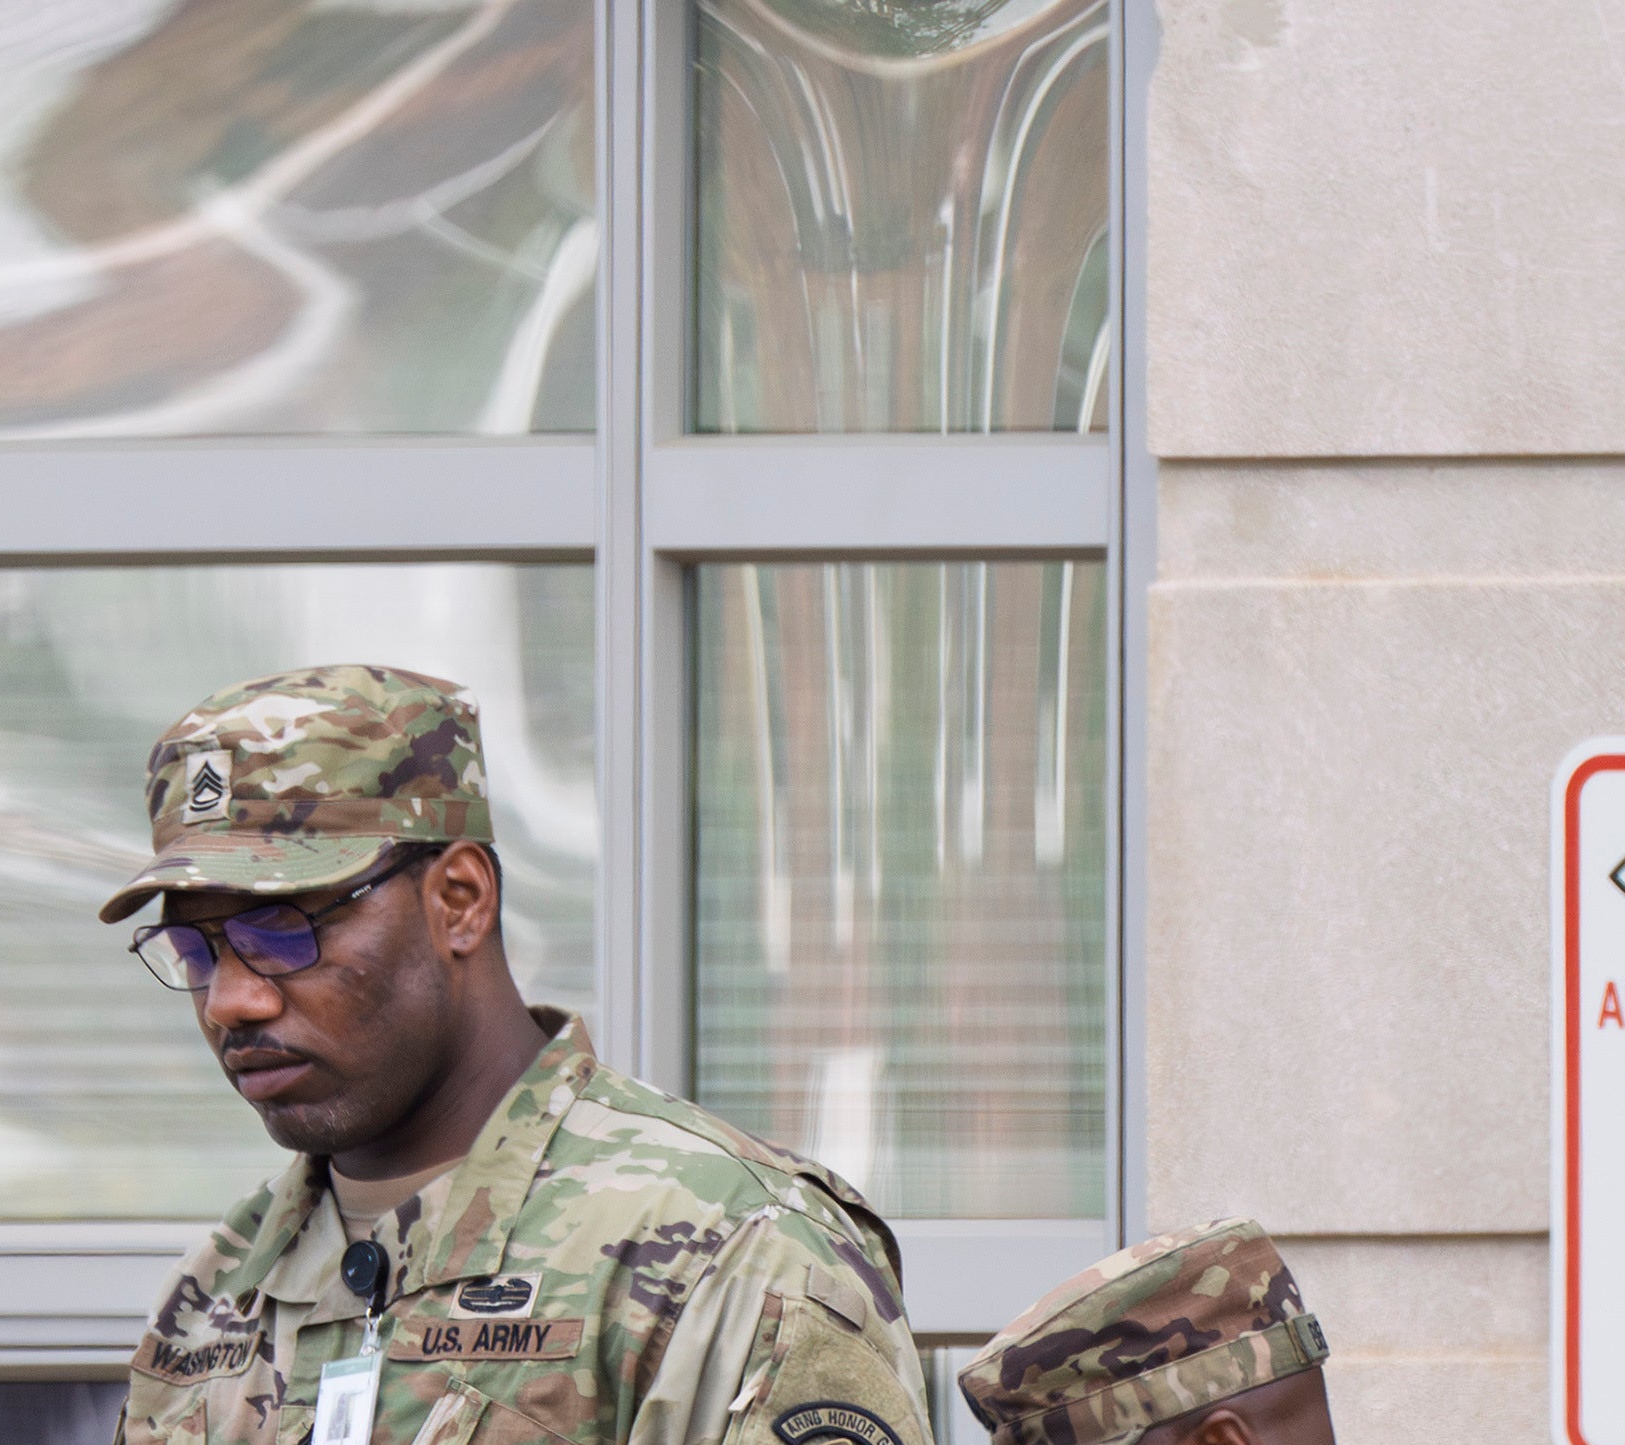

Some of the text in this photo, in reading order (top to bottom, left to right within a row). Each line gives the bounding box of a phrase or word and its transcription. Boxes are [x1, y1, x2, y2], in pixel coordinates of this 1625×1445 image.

[422, 1323, 552, 1355] U.S. ARMY
[828, 1410, 876, 1438] HONOR
